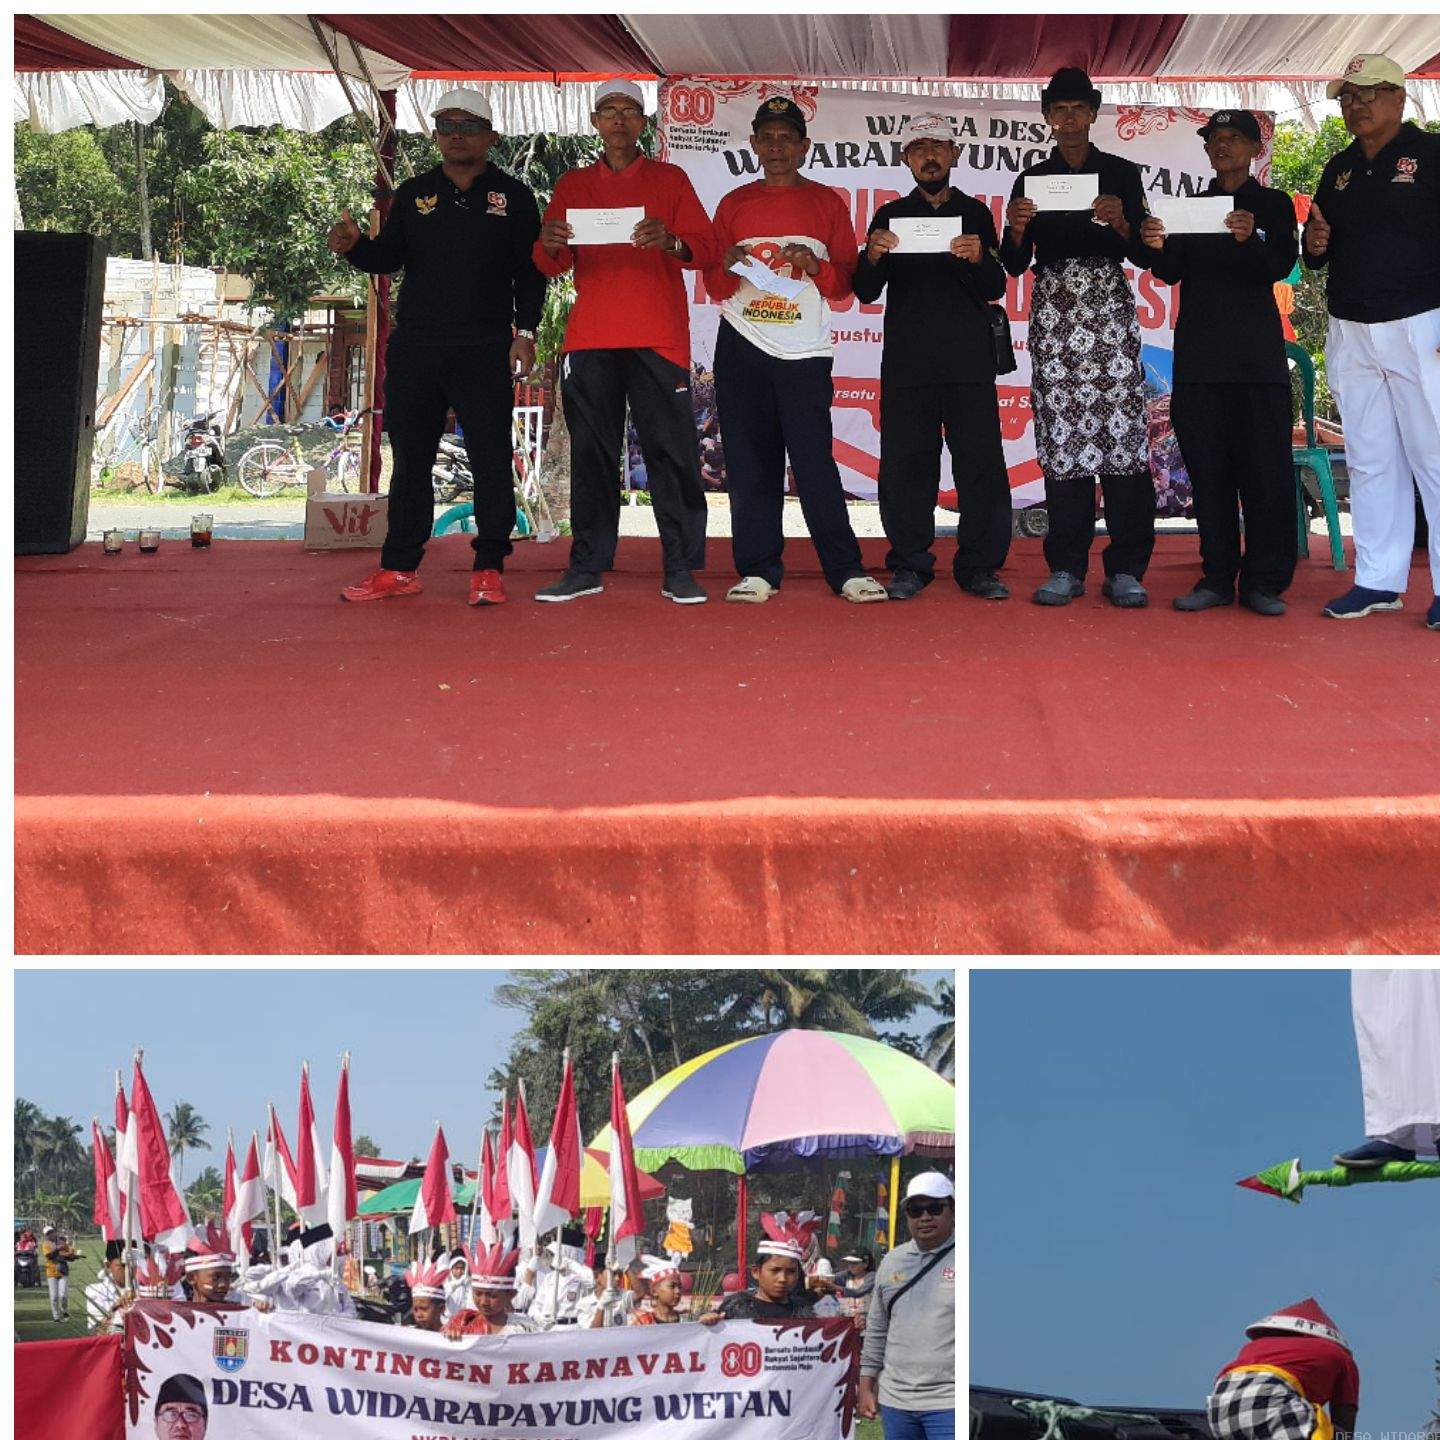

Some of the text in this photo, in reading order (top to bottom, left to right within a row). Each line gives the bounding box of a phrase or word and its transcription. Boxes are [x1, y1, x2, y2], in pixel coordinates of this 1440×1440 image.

[669, 84, 715, 126] 80
[865, 114, 978, 138] WAGA
[742, 306, 802, 320] INDONESIA
[322, 502, 380, 537] Vit
[269, 1338, 706, 1385] KONTINGEN KARNAVAL
[720, 1341, 762, 1378] 80
[211, 1377, 793, 1428] DESA WIDARAPAYUNG WETAN
